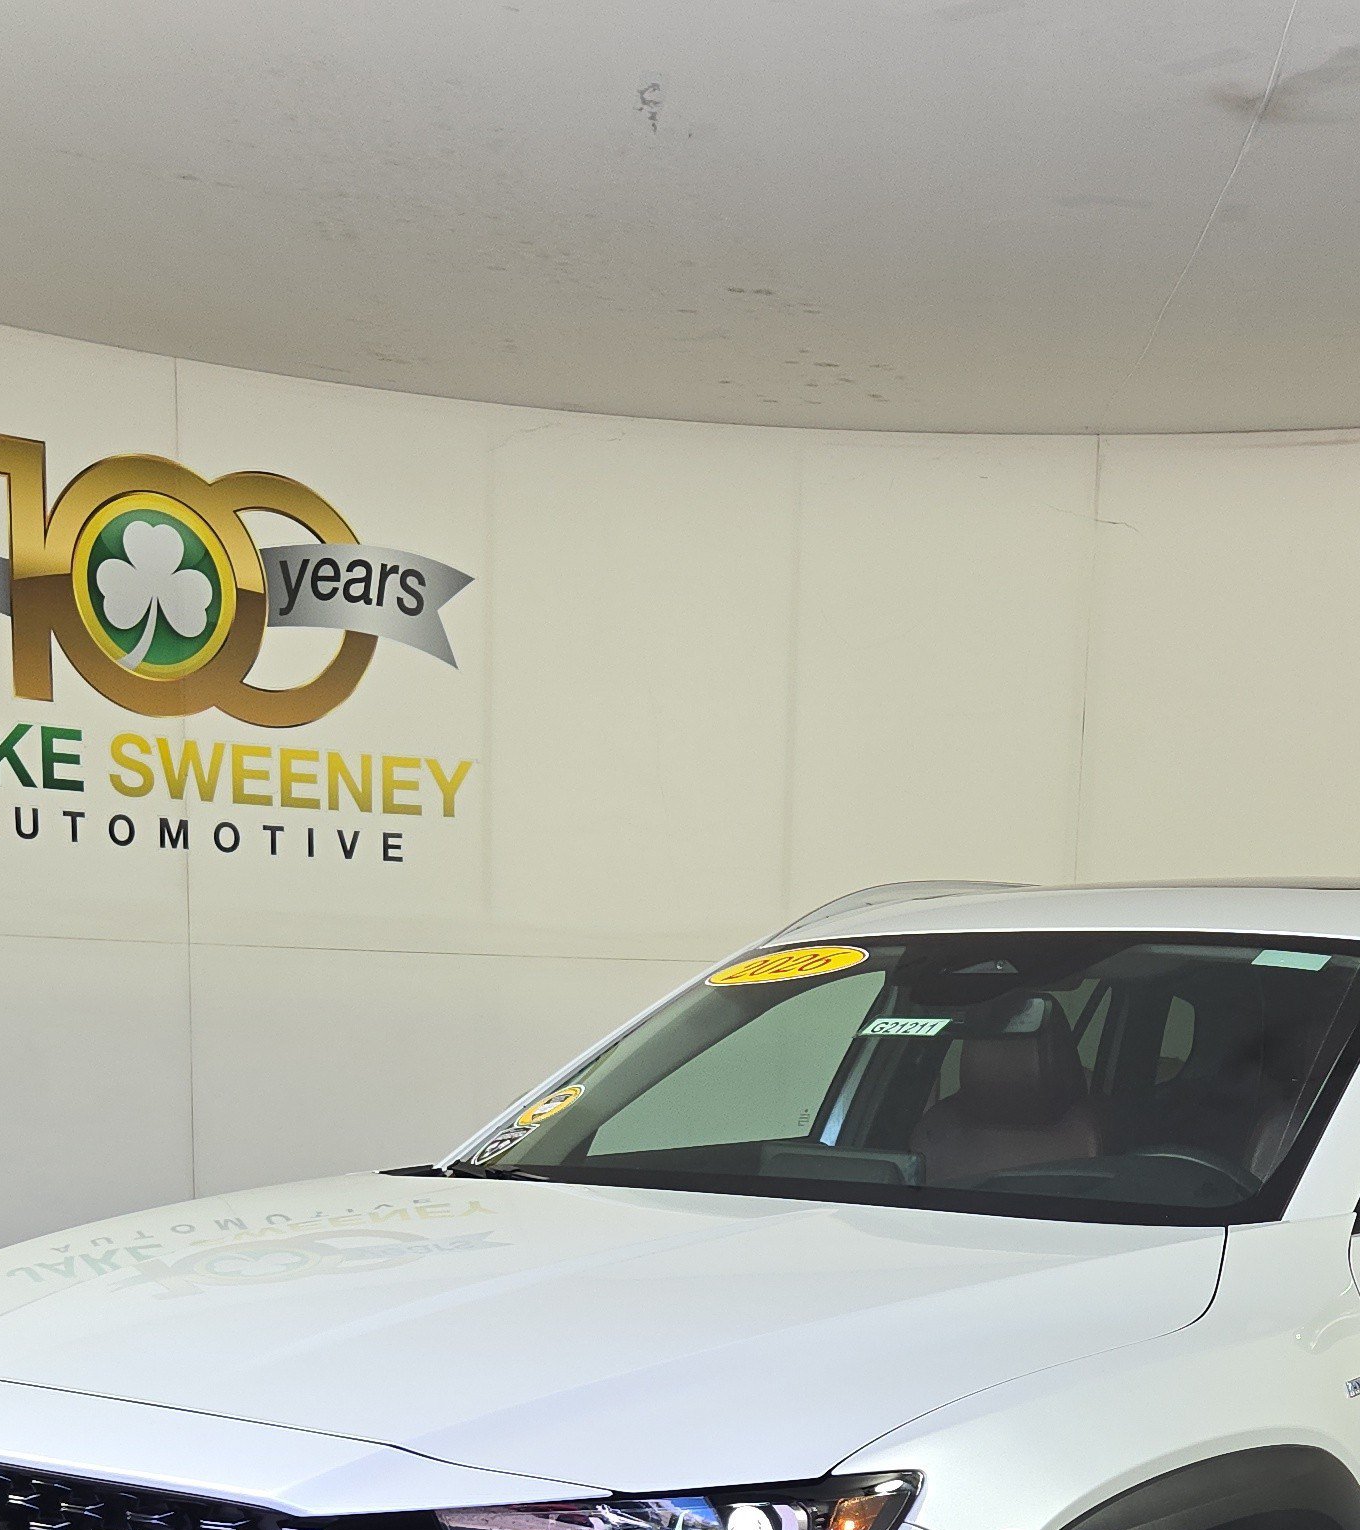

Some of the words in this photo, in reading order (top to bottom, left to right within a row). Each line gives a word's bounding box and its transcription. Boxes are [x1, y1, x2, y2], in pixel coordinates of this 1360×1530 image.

[279, 554, 427, 617] years
[109, 732, 473, 818] SWEENEY
[721, 951, 851, 981] 2026
[871, 1021, 940, 1034] G21211
